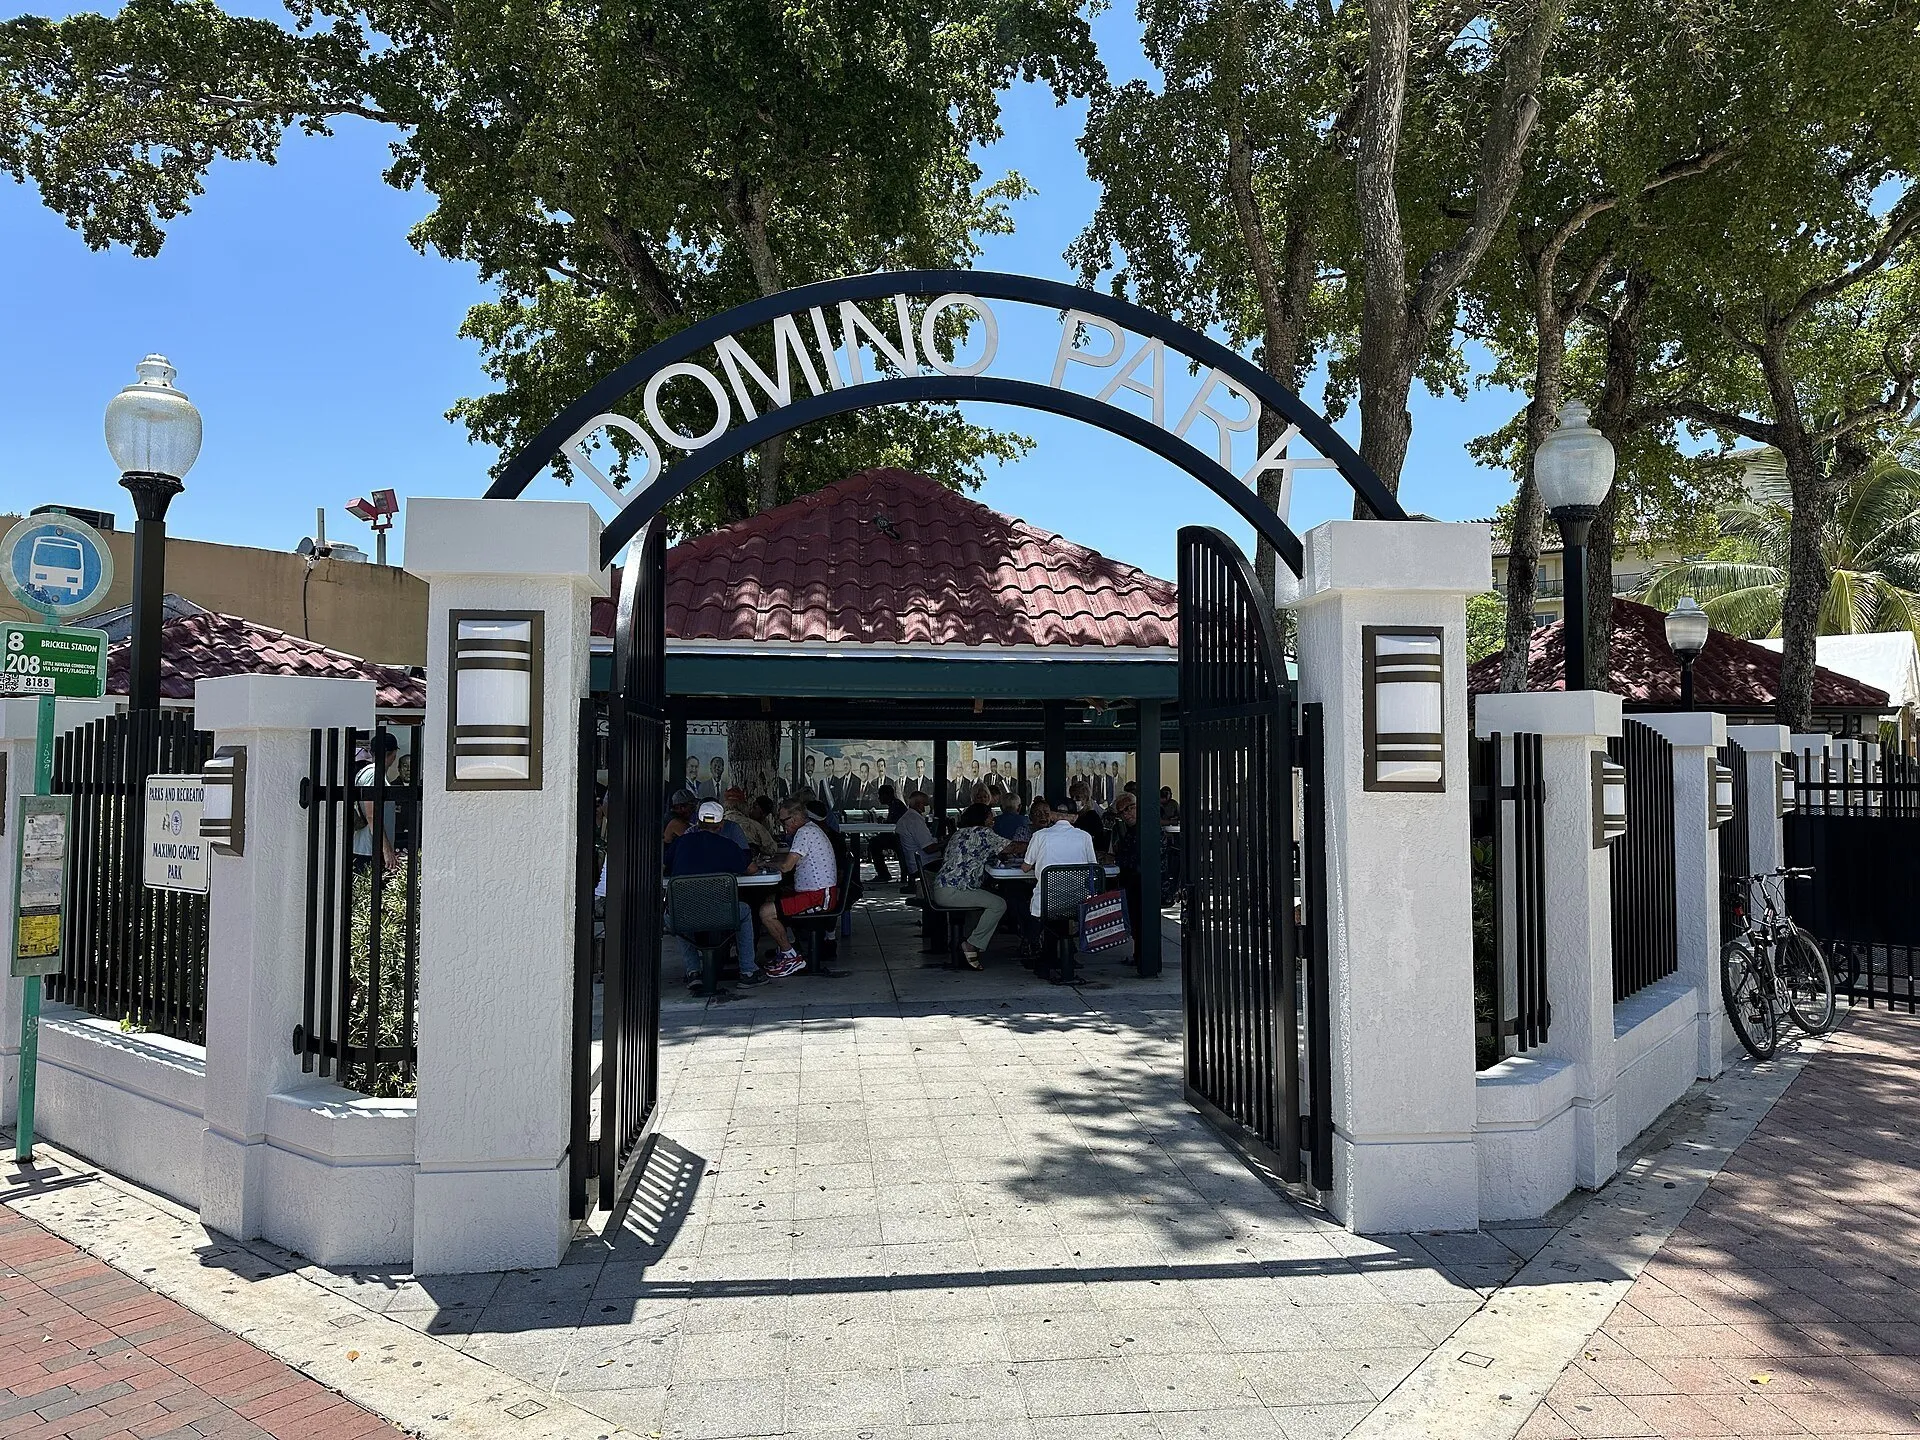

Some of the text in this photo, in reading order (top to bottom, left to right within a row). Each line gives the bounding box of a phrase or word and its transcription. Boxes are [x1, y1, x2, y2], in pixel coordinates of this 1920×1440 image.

[559, 292, 1339, 525] DOMINO PARK
[7, 631, 24, 651] 8
[41, 639, 98, 653] BRICKELL STATION
[5, 653, 40, 675] 208
[25, 677, 49, 687] 8188
[148, 787, 205, 803] PARKS AND RECREATIO
[152, 842, 200, 861] MAXIMO GOMEZ
[167, 864, 183, 880] PARK
